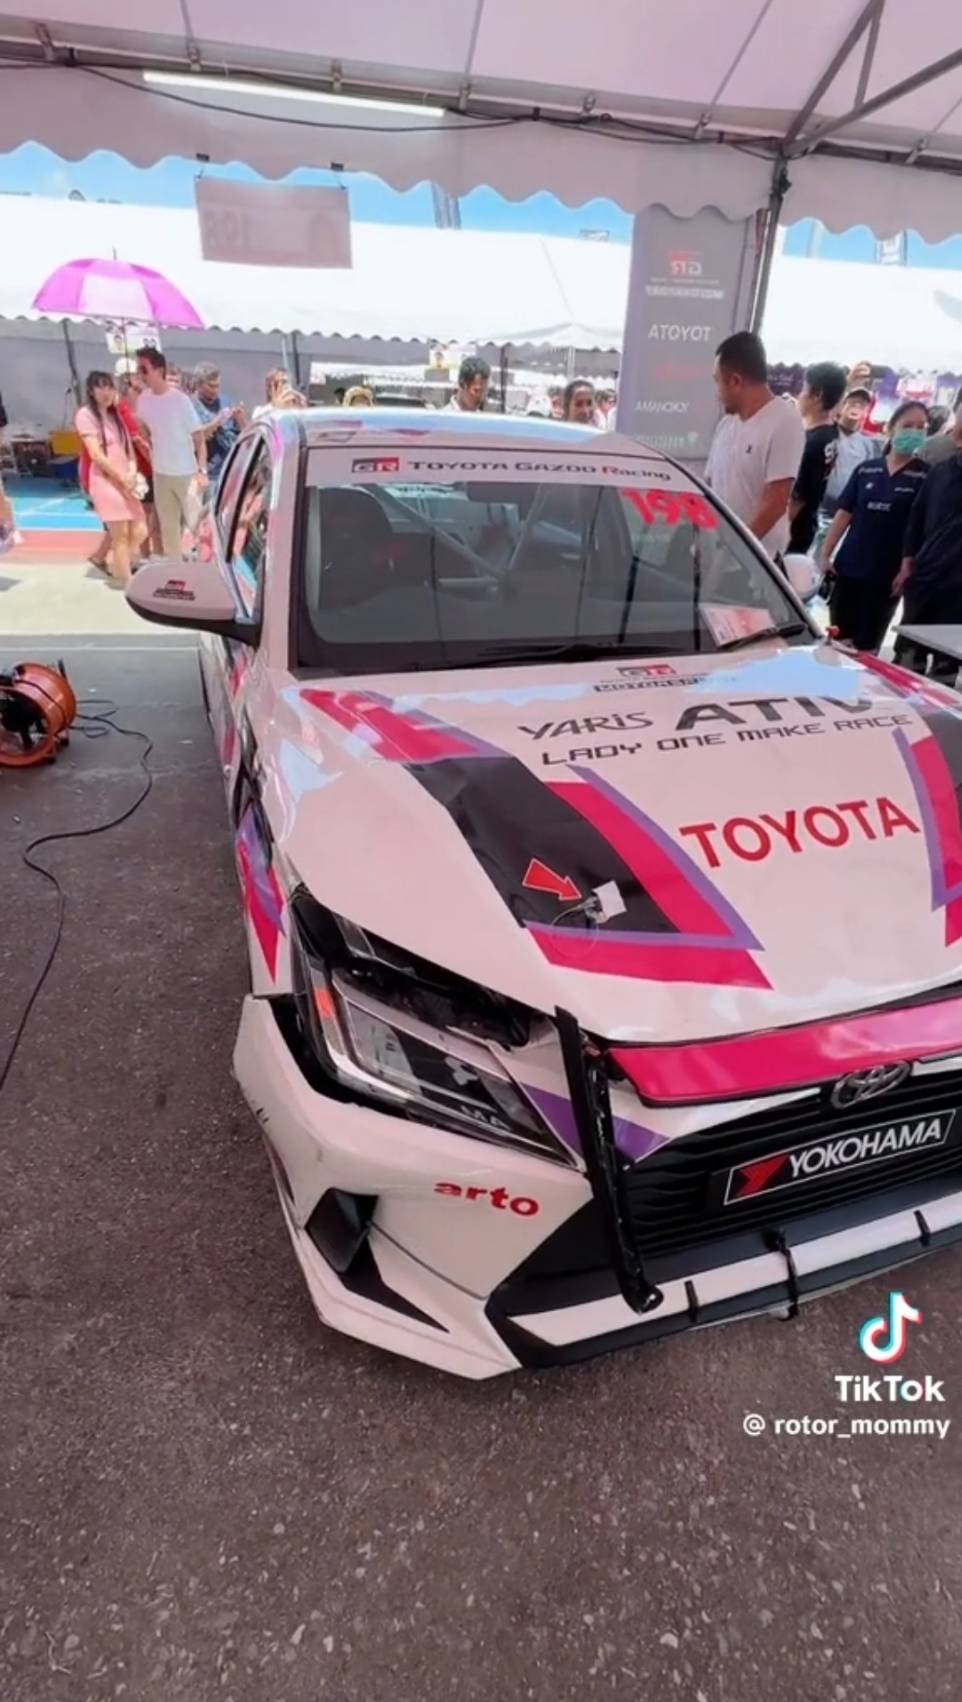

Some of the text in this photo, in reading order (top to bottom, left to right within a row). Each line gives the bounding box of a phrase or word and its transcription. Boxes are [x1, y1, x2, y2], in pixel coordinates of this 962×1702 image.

[352, 459, 672, 481] GR TOYOTA GAZOO Racing
[675, 696, 874, 731] ATIV
[542, 714, 913, 765] LADY ONE MAKE RACE
[679, 797, 921, 868] TOYOTA
[789, 1118, 941, 1178] YOKOHAMA
[434, 1182, 539, 1217] arto
